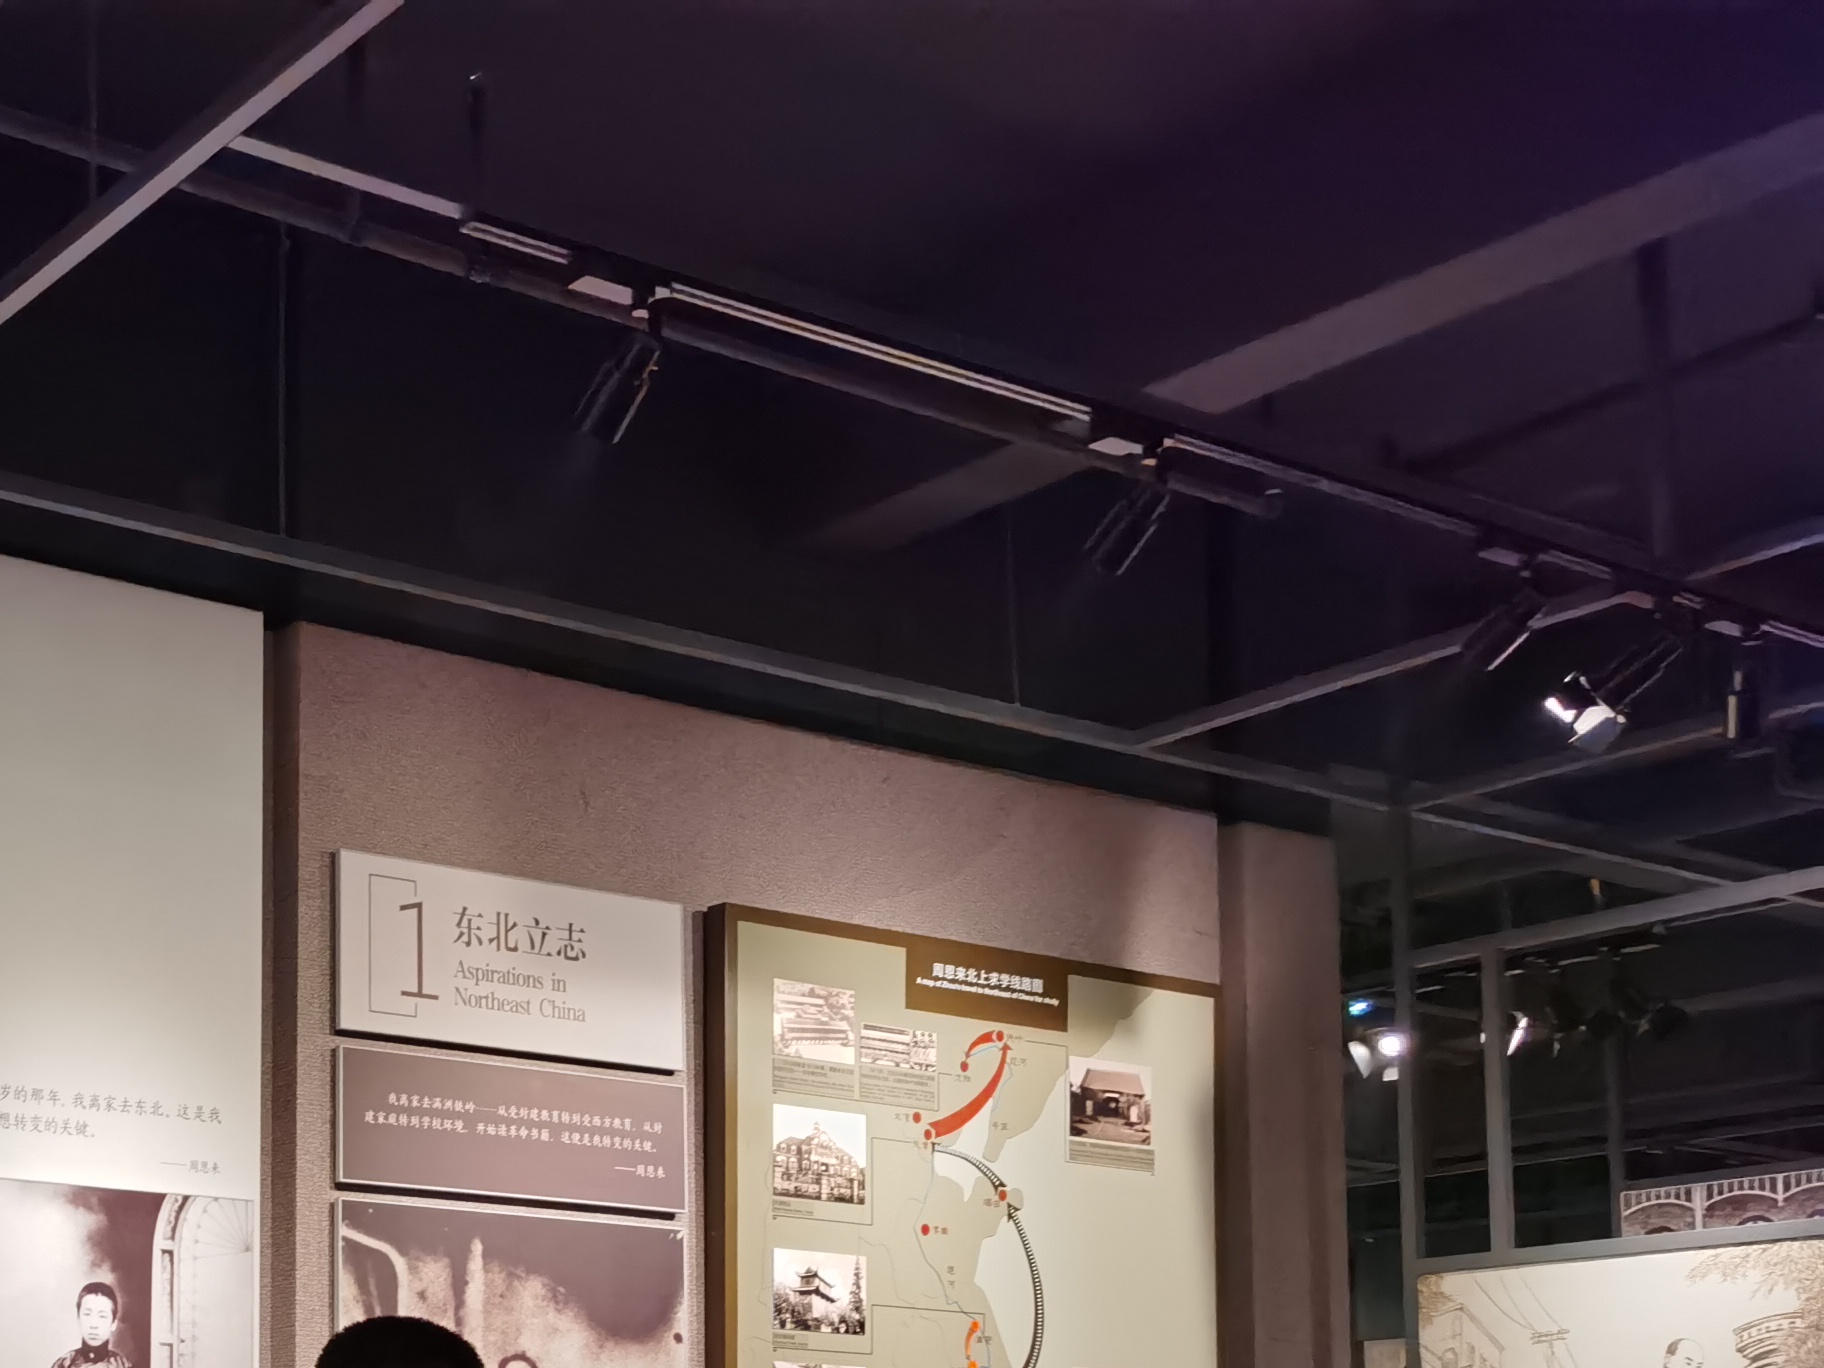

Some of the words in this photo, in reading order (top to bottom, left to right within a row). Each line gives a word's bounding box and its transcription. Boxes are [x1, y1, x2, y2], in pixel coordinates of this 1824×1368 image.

[398, 901, 440, 1001] 1
[452, 905, 588, 962] 东北立志
[453, 959, 545, 990] Aspirations
[551, 971, 567, 993] in
[454, 986, 532, 1016] Northeast
[539, 998, 586, 1023] China
